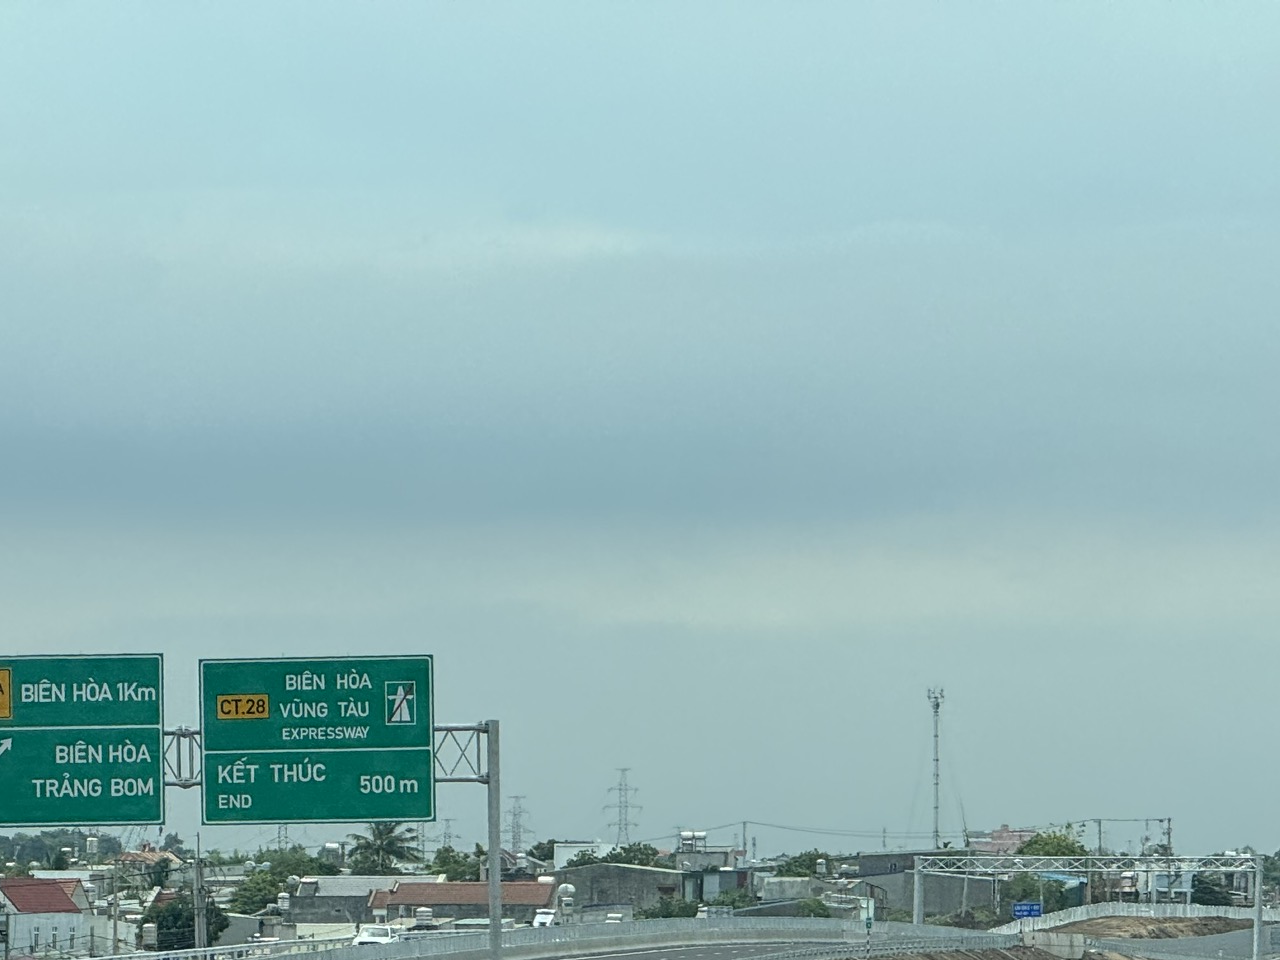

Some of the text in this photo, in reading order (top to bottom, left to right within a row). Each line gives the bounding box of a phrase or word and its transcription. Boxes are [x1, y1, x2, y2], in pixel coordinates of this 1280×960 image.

[21, 677, 156, 703] BIÊN HÒA 1Km
[285, 669, 372, 691] BIÊN HÒA
[220, 698, 266, 716] CT.28
[279, 697, 370, 718] VŨNG TÀU
[282, 726, 370, 740] EXPRESSWAY
[55, 739, 151, 764] BIÊN HÒA
[218, 757, 326, 784] KẾT THÚC
[32, 772, 154, 798] TRẢNG BOM
[360, 775, 418, 794] 500 m
[218, 794, 252, 809] END
